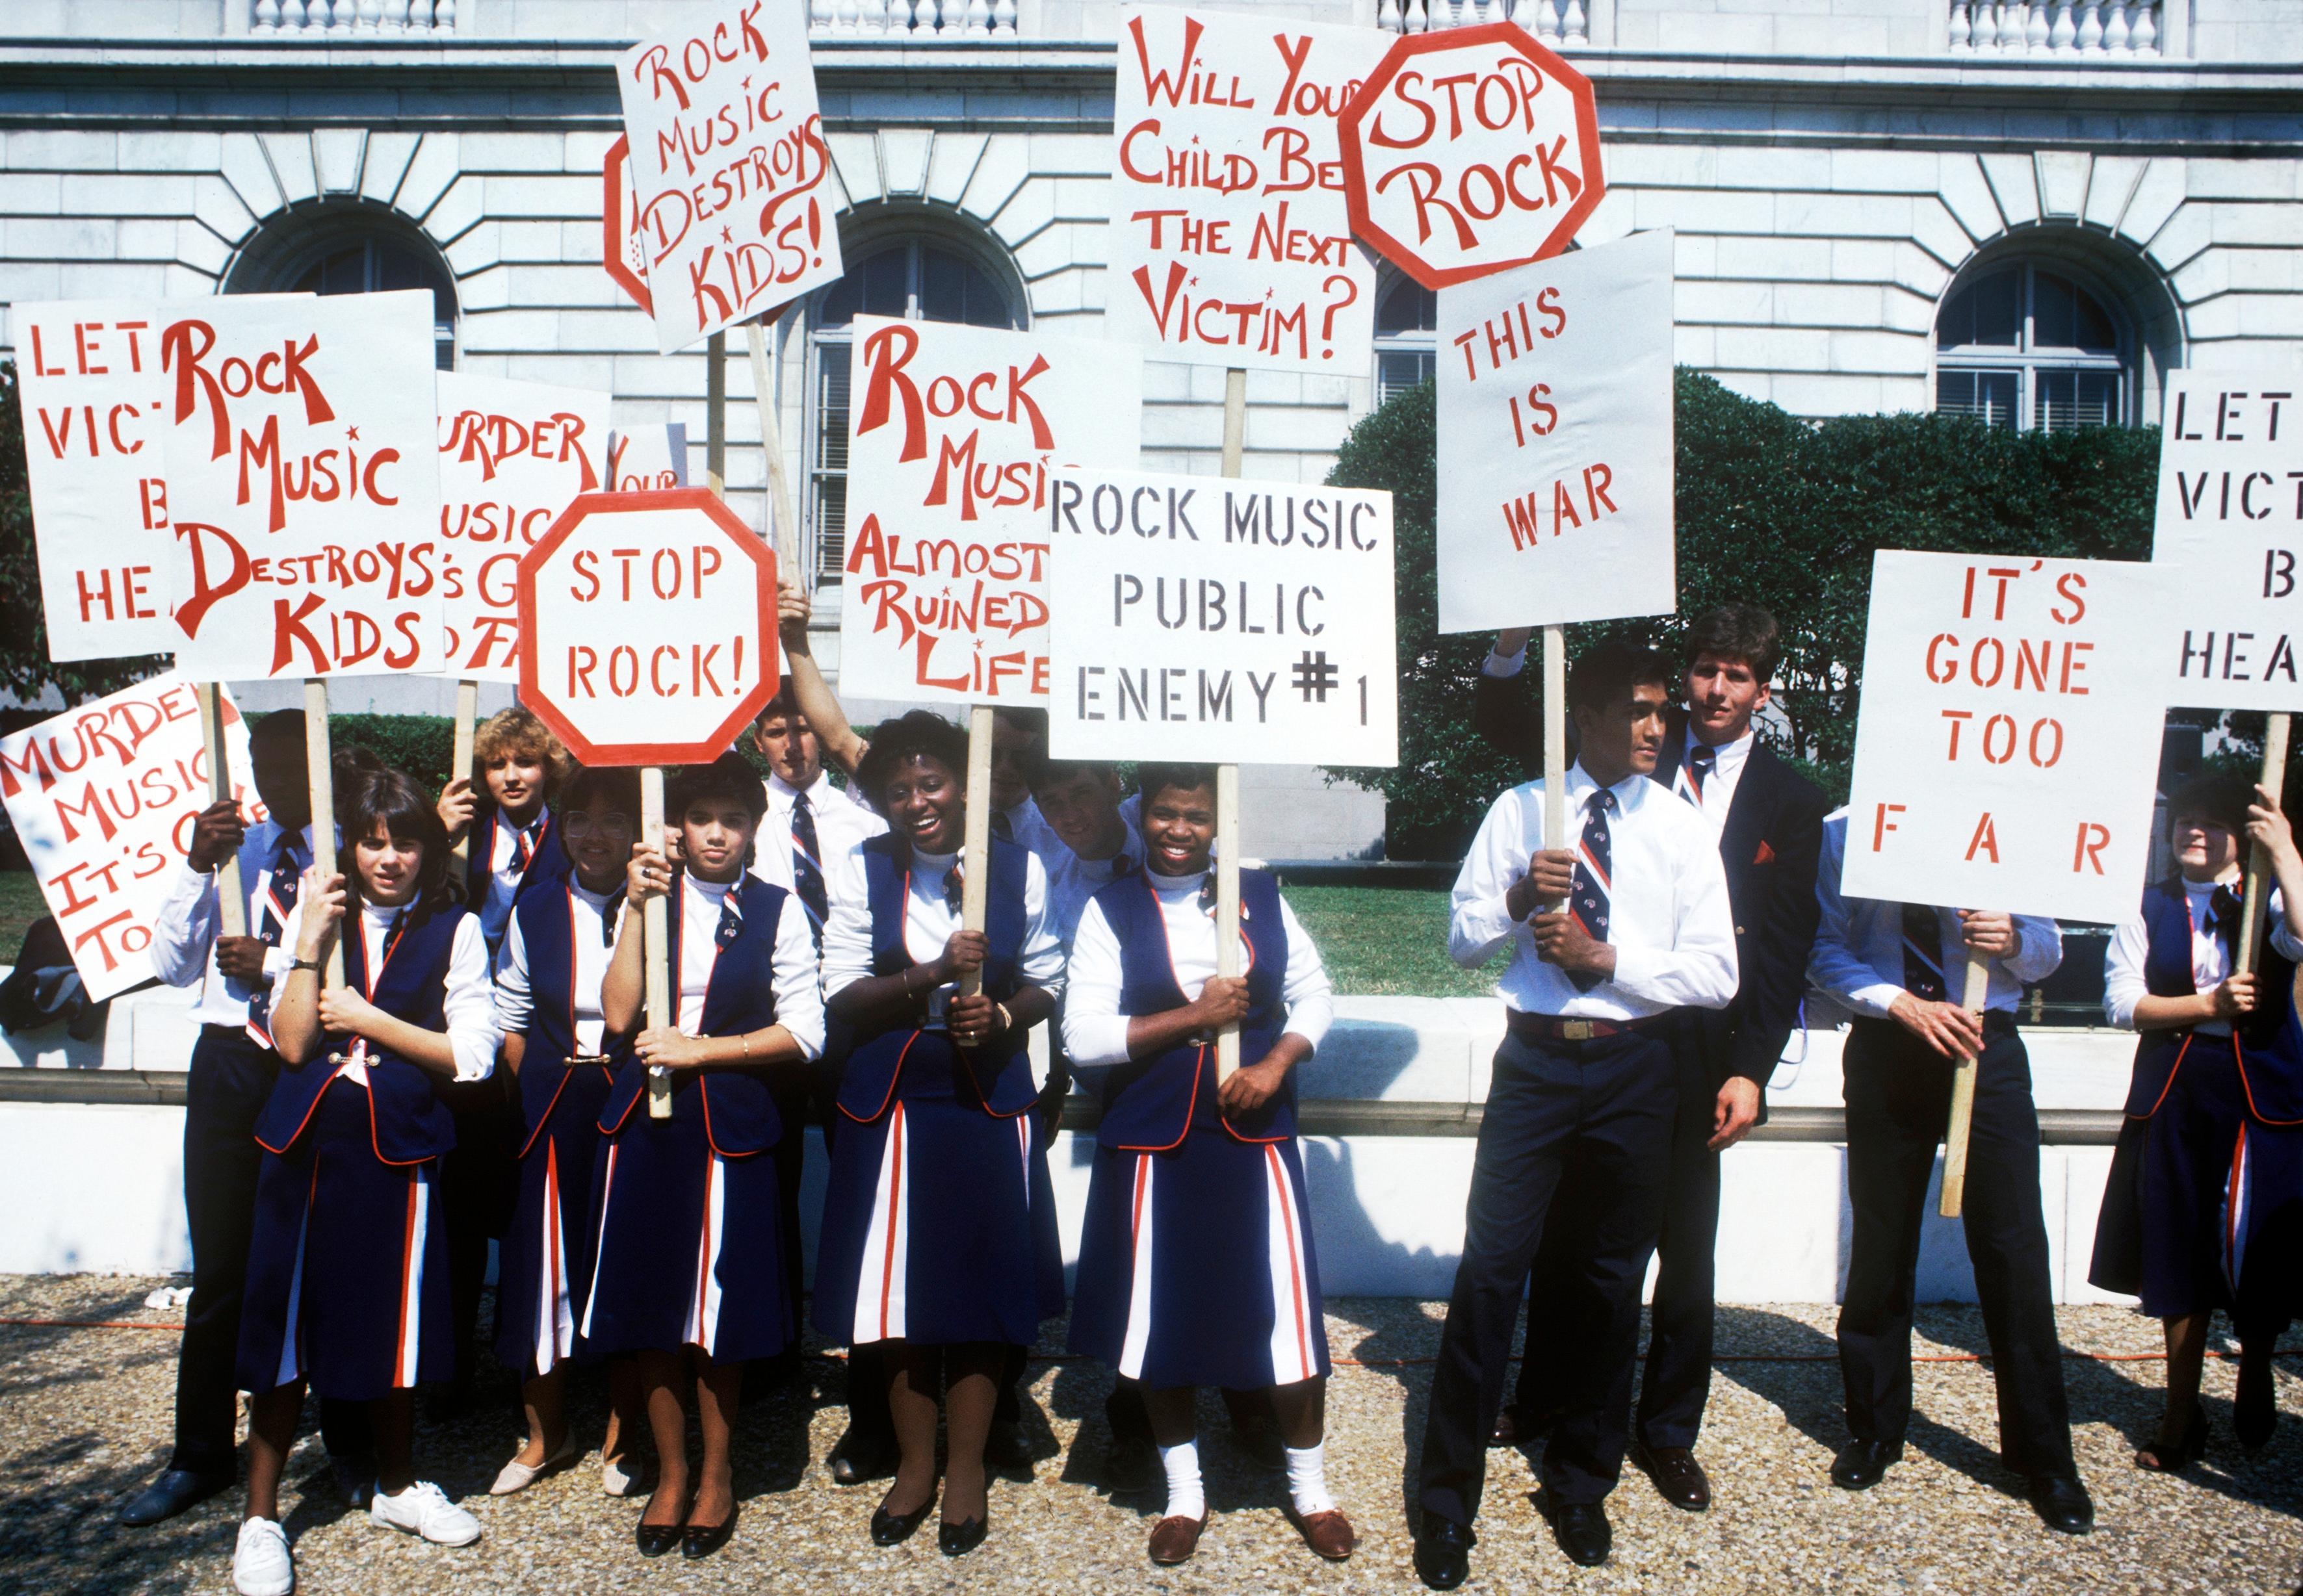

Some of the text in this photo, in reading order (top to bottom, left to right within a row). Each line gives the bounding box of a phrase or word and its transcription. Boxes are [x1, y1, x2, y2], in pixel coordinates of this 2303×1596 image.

[635, 0, 768, 110] ROCK
[1369, 58, 1543, 149] STOP
[641, 114, 830, 267] DESTROYS
[1262, 127, 1346, 196] BE
[1376, 135, 1581, 250] ROCK
[1132, 201, 1355, 266] THE NEXT
[31, 322, 148, 376] LET
[1455, 288, 1565, 380] THIS
[161, 320, 335, 461] ROCK
[857, 325, 1054, 463] ROCK
[1510, 384, 1557, 446] IS
[2176, 393, 2291, 441] LET
[38, 402, 161, 459] VIC
[438, 411, 598, 493] URDER
[924, 429, 1081, 521] MUSI
[1503, 464, 1617, 551] WAR
[441, 502, 552, 546] USIC
[1053, 481, 1376, 550] ROCK MUSIC
[77, 566, 173, 622] HE
[170, 523, 434, 640] DESTROYS
[571, 546, 722, 602] STOP
[1115, 575, 1323, 635] PUBLIC
[1962, 560, 2086, 624] IT'S
[2264, 550, 2295, 597] B
[269, 592, 420, 676] KIDS
[1927, 634, 2093, 694] GONE
[569, 636, 743, 698] ROCK!
[1079, 668, 1275, 722] ENEMY
[1942, 710, 2062, 767] TOO
[48, 842, 166, 918] IT'S
[75, 910, 161, 972] TO
